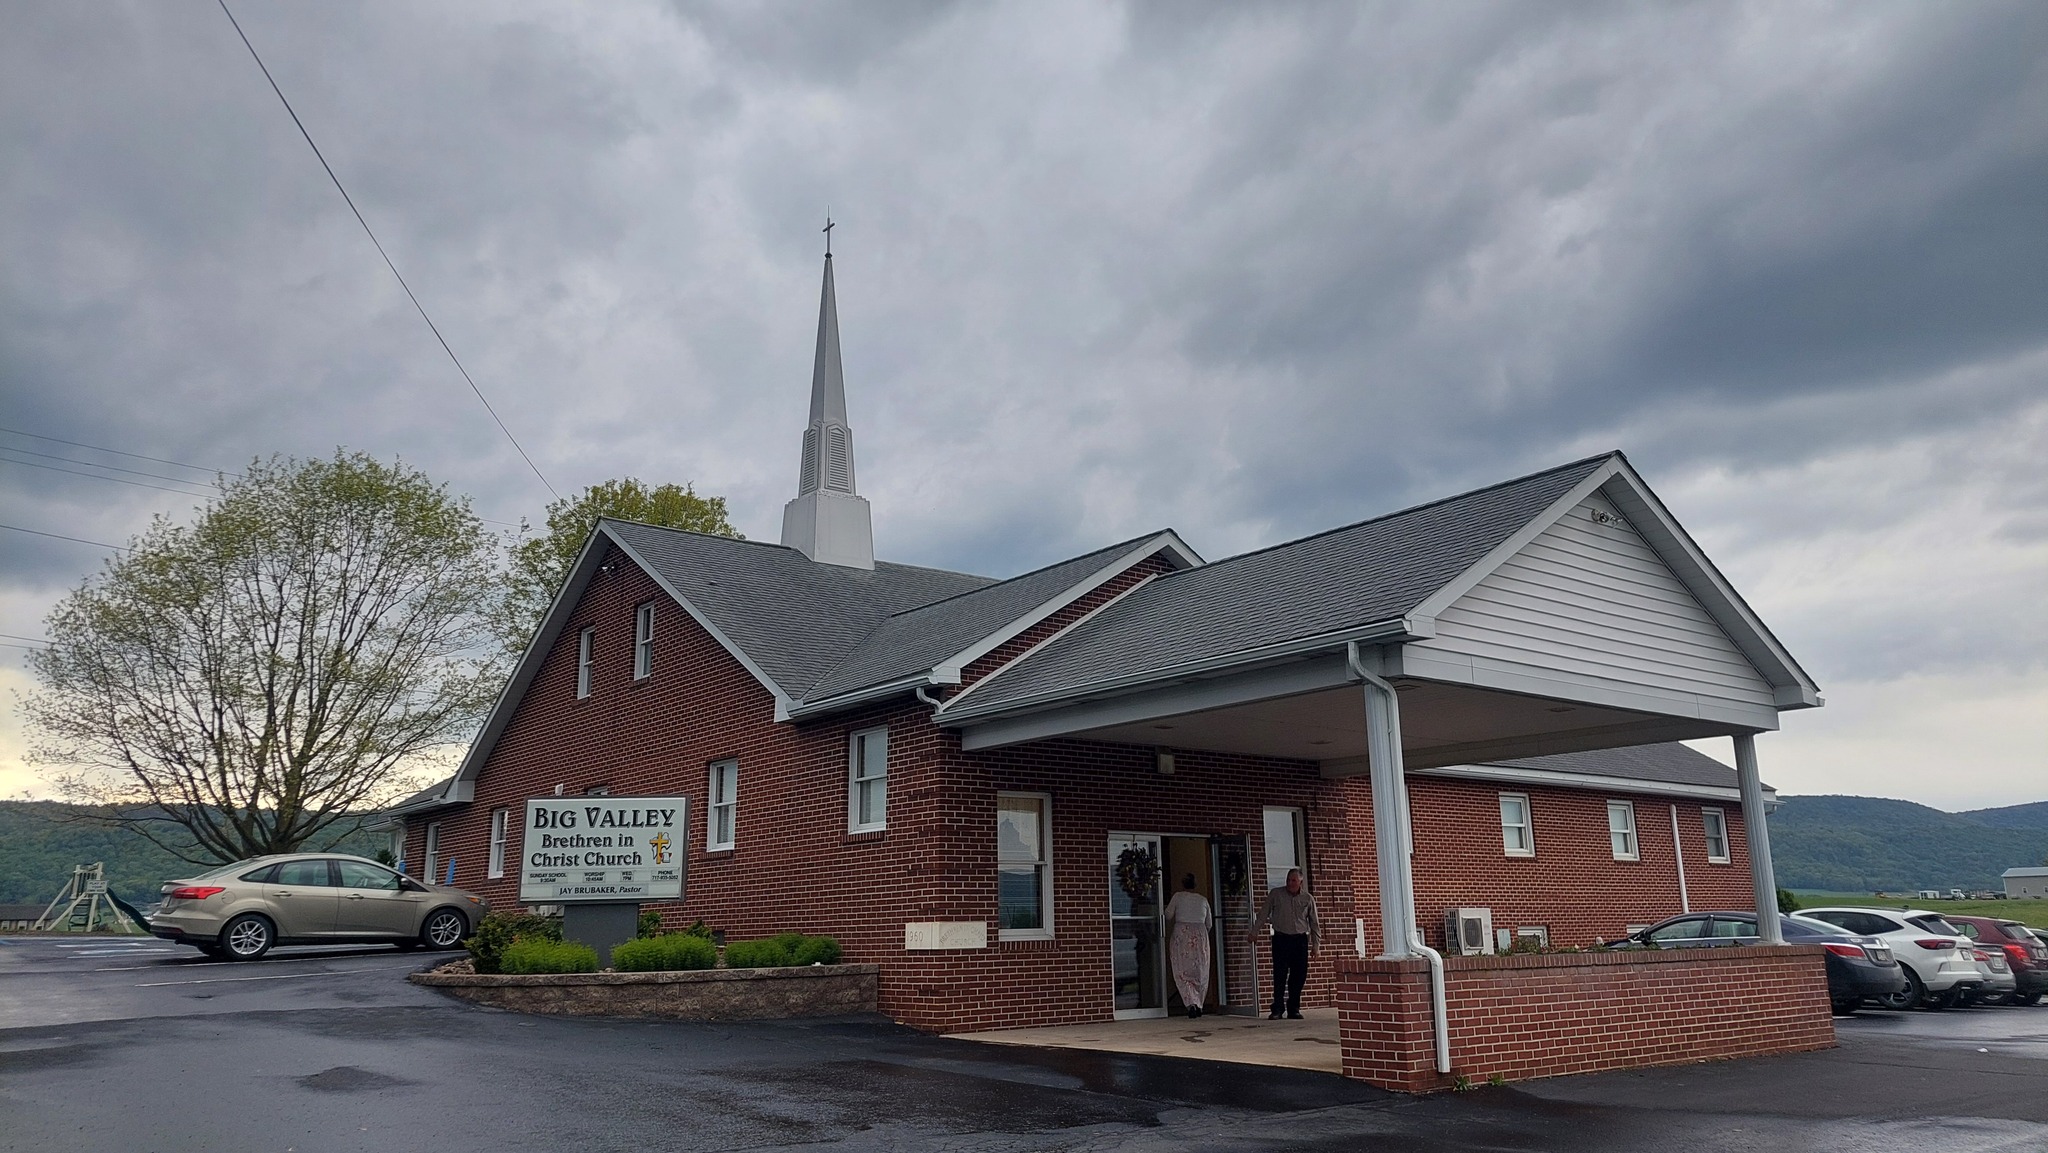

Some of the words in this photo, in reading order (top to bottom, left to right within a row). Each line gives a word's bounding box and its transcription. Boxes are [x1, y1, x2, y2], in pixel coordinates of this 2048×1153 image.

[533, 807, 577, 829] BIG
[584, 806, 676, 828] VALLEY
[541, 833, 613, 849] Brethren
[617, 833, 634, 848] in
[530, 852, 580, 868] Christ
[583, 850, 642, 867] Church
[559, 887, 572, 896] JAY
[574, 886, 617, 895] BRUBAKER,
